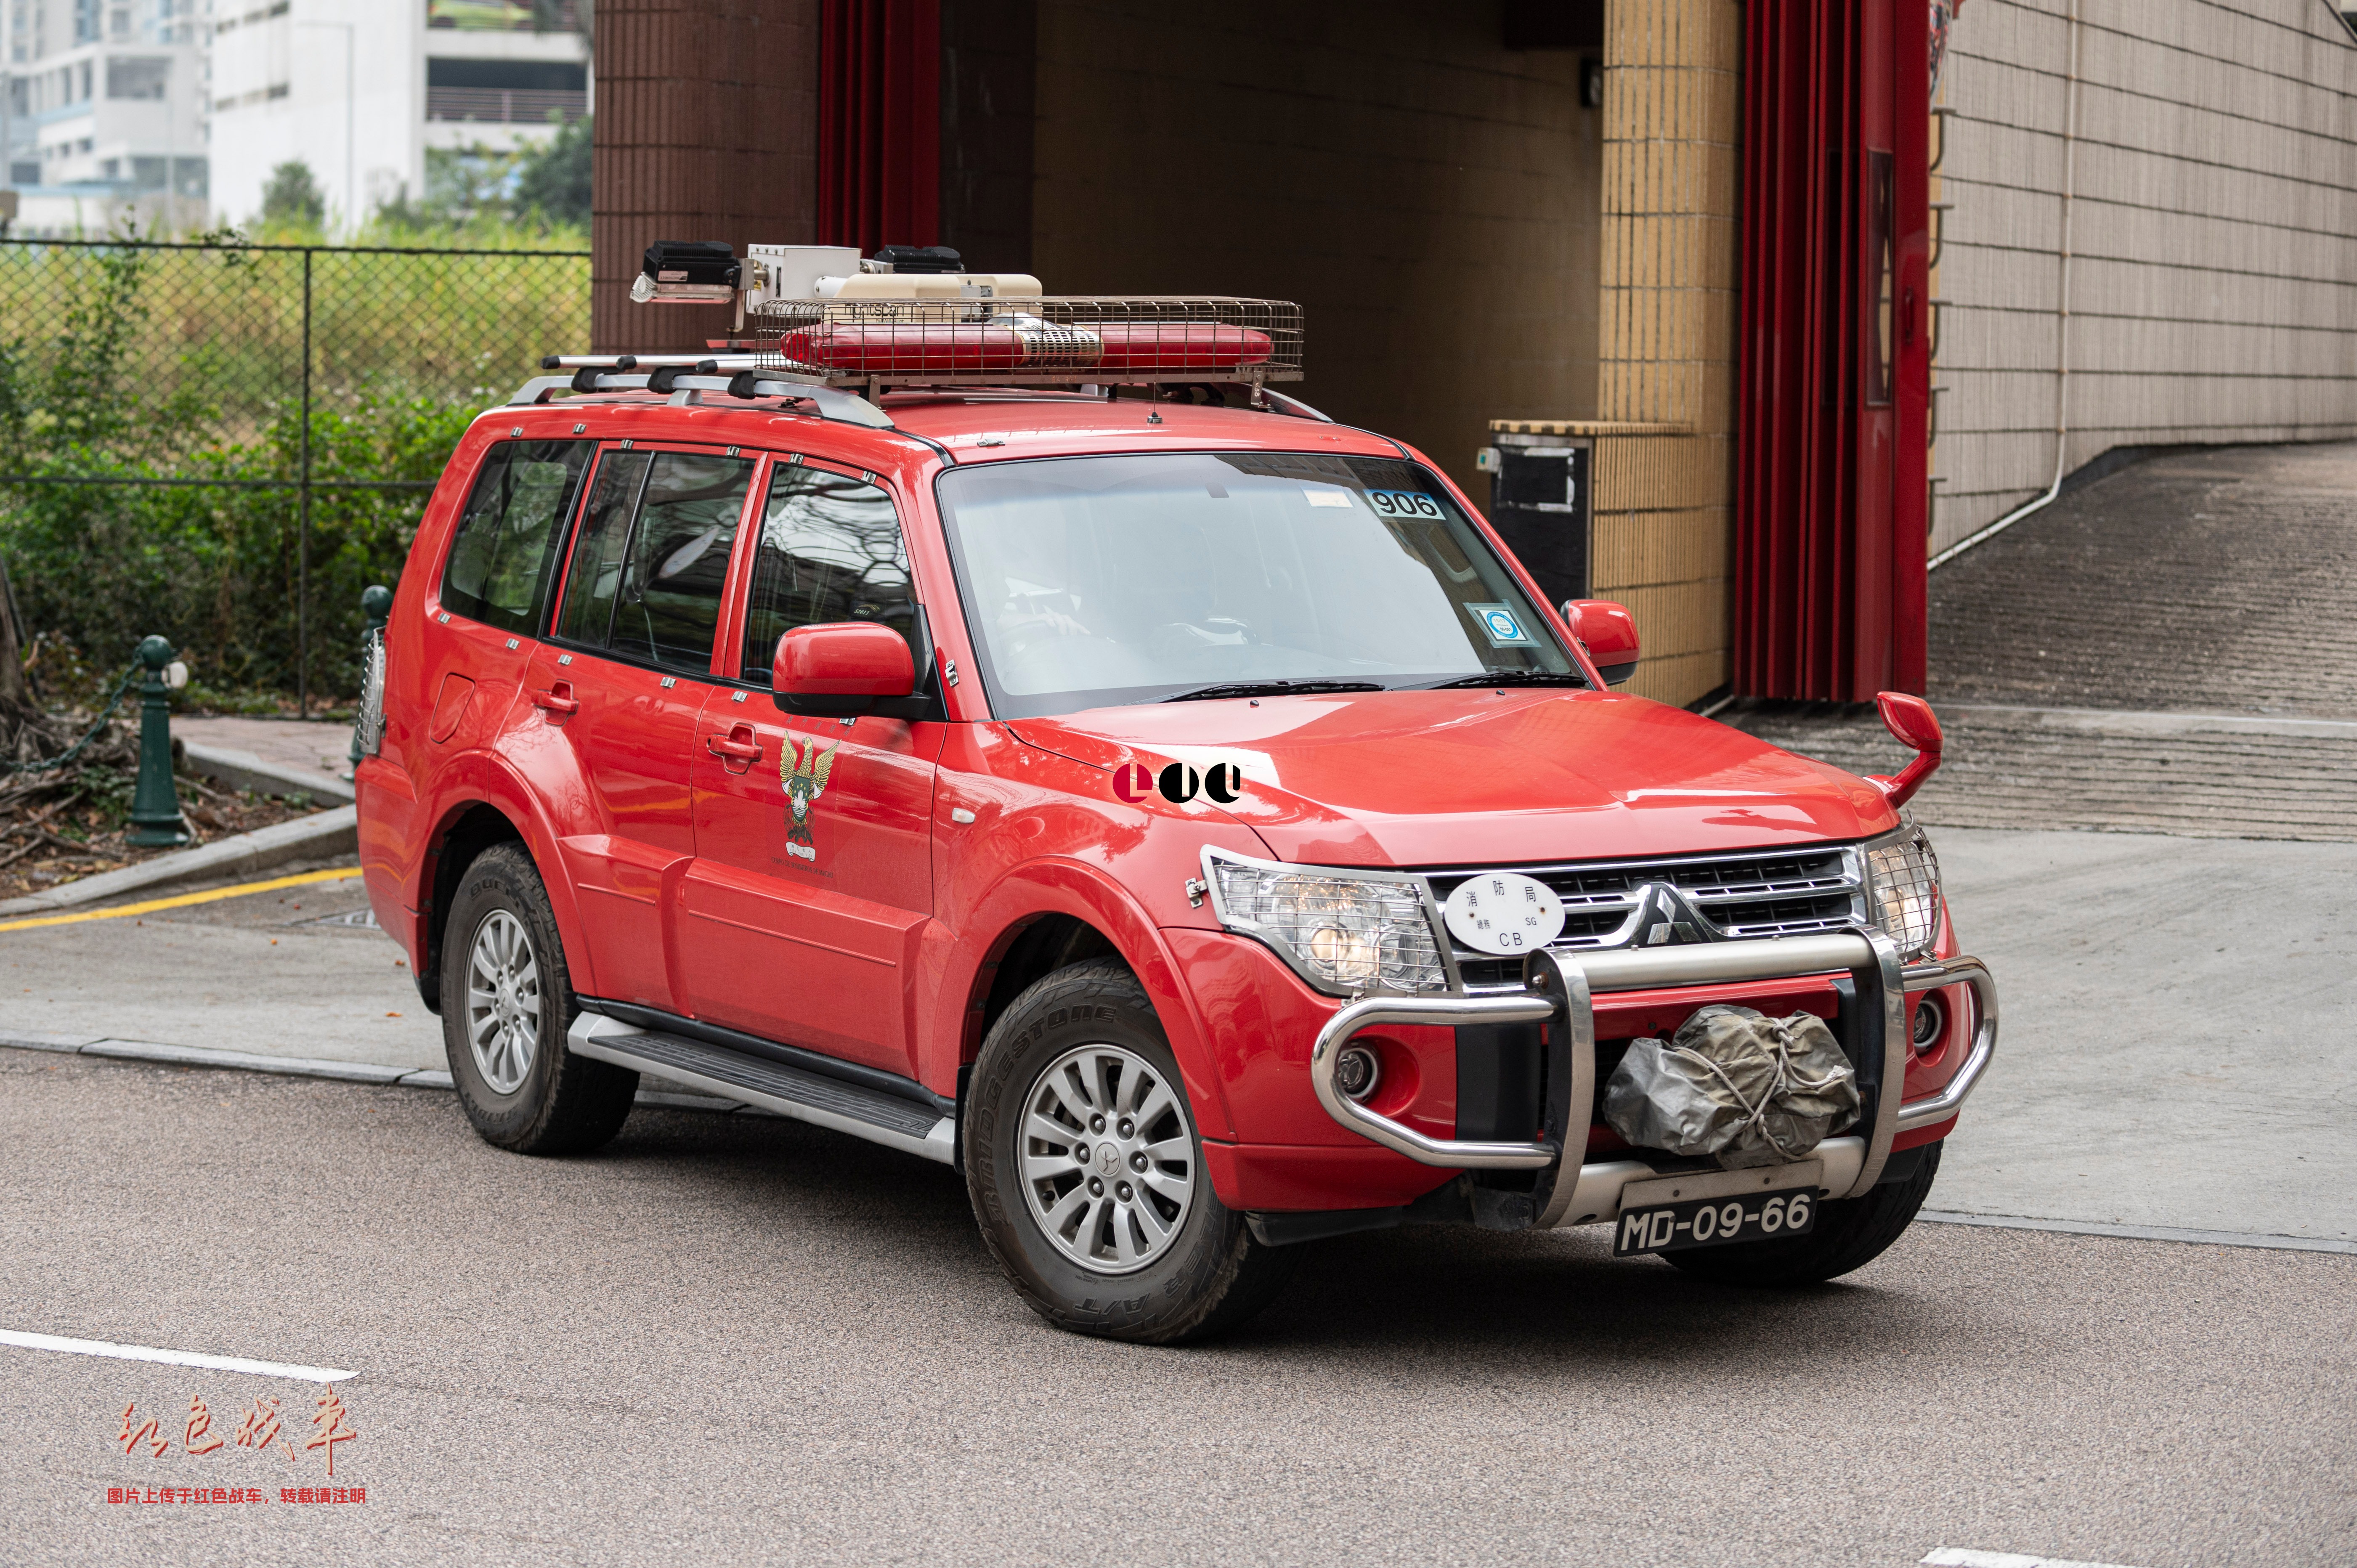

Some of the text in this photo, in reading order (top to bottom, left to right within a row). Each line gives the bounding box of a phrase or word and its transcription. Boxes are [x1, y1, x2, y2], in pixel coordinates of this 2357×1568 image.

[1372, 492, 1437, 516] 906
[1466, 880, 1536, 907] 消防局
[1525, 917, 1537, 926] SG
[1621, 1194, 1810, 1250] MD-09-66
